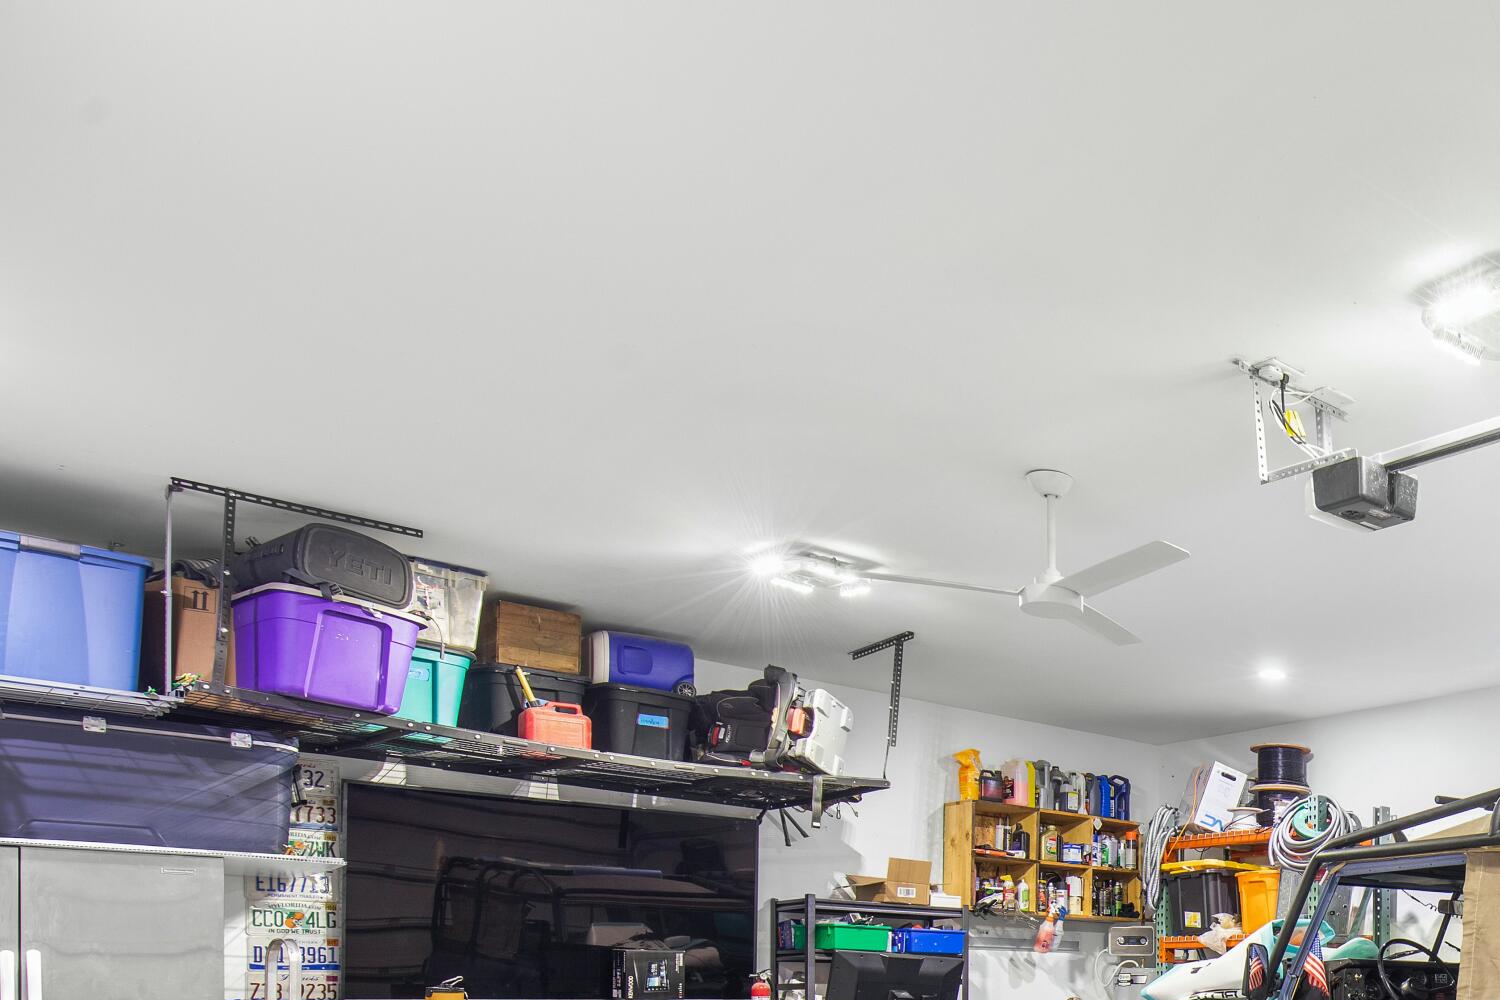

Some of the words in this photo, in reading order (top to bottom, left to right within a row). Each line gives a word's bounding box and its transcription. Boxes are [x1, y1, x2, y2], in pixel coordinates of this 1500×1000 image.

[328, 547, 393, 586] YETI
[306, 911, 337, 928] 4LG
[301, 984, 337, 1000] 235
